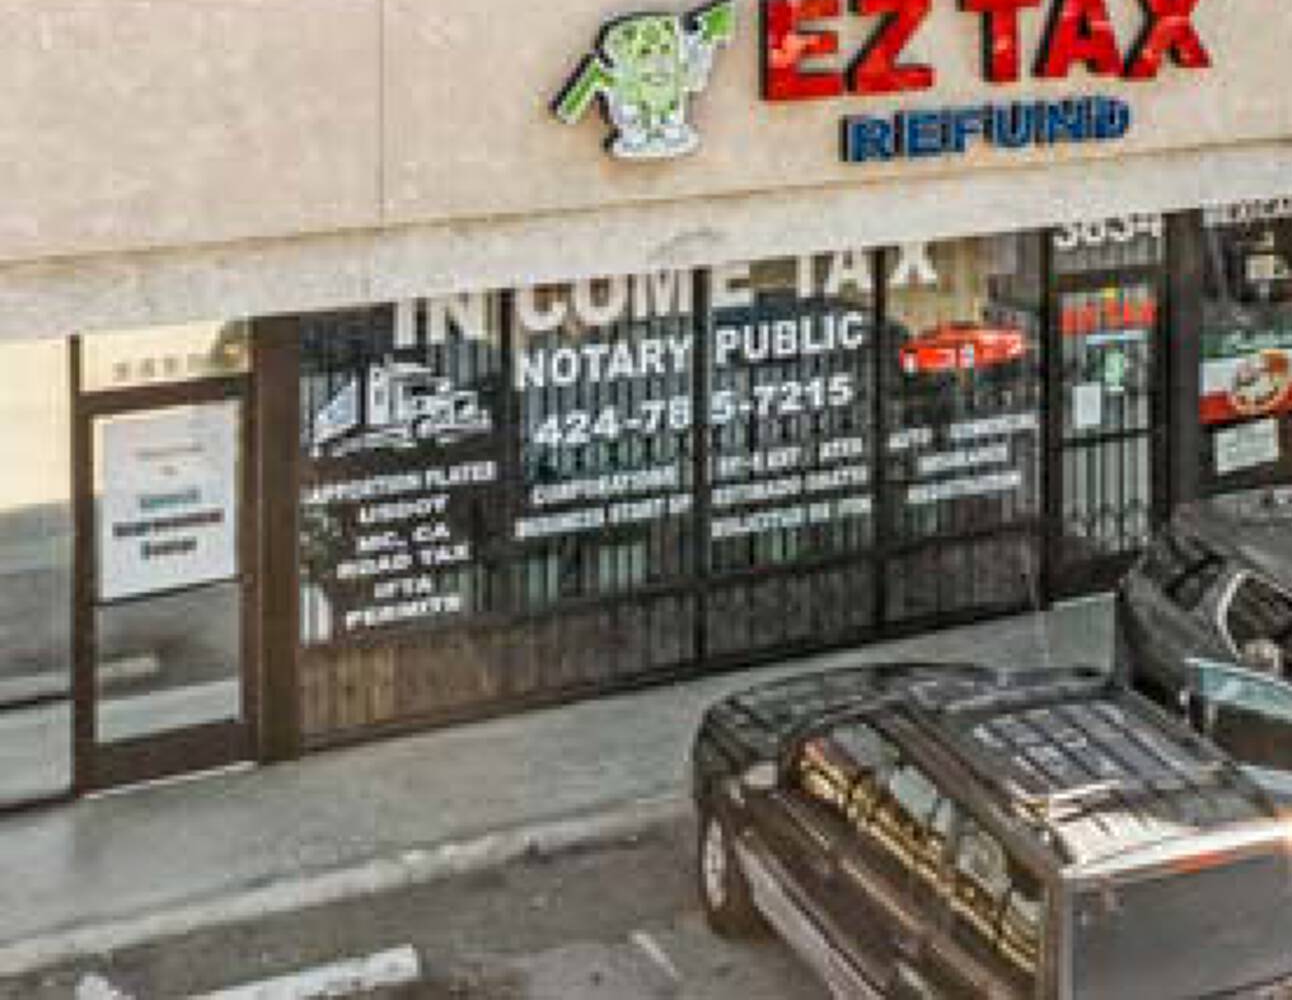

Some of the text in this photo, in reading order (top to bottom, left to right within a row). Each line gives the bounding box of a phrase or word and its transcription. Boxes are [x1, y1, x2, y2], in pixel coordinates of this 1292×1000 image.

[840, 96, 1130, 162] REFUND
[517, 311, 865, 391] NOTARY PUBLIC
